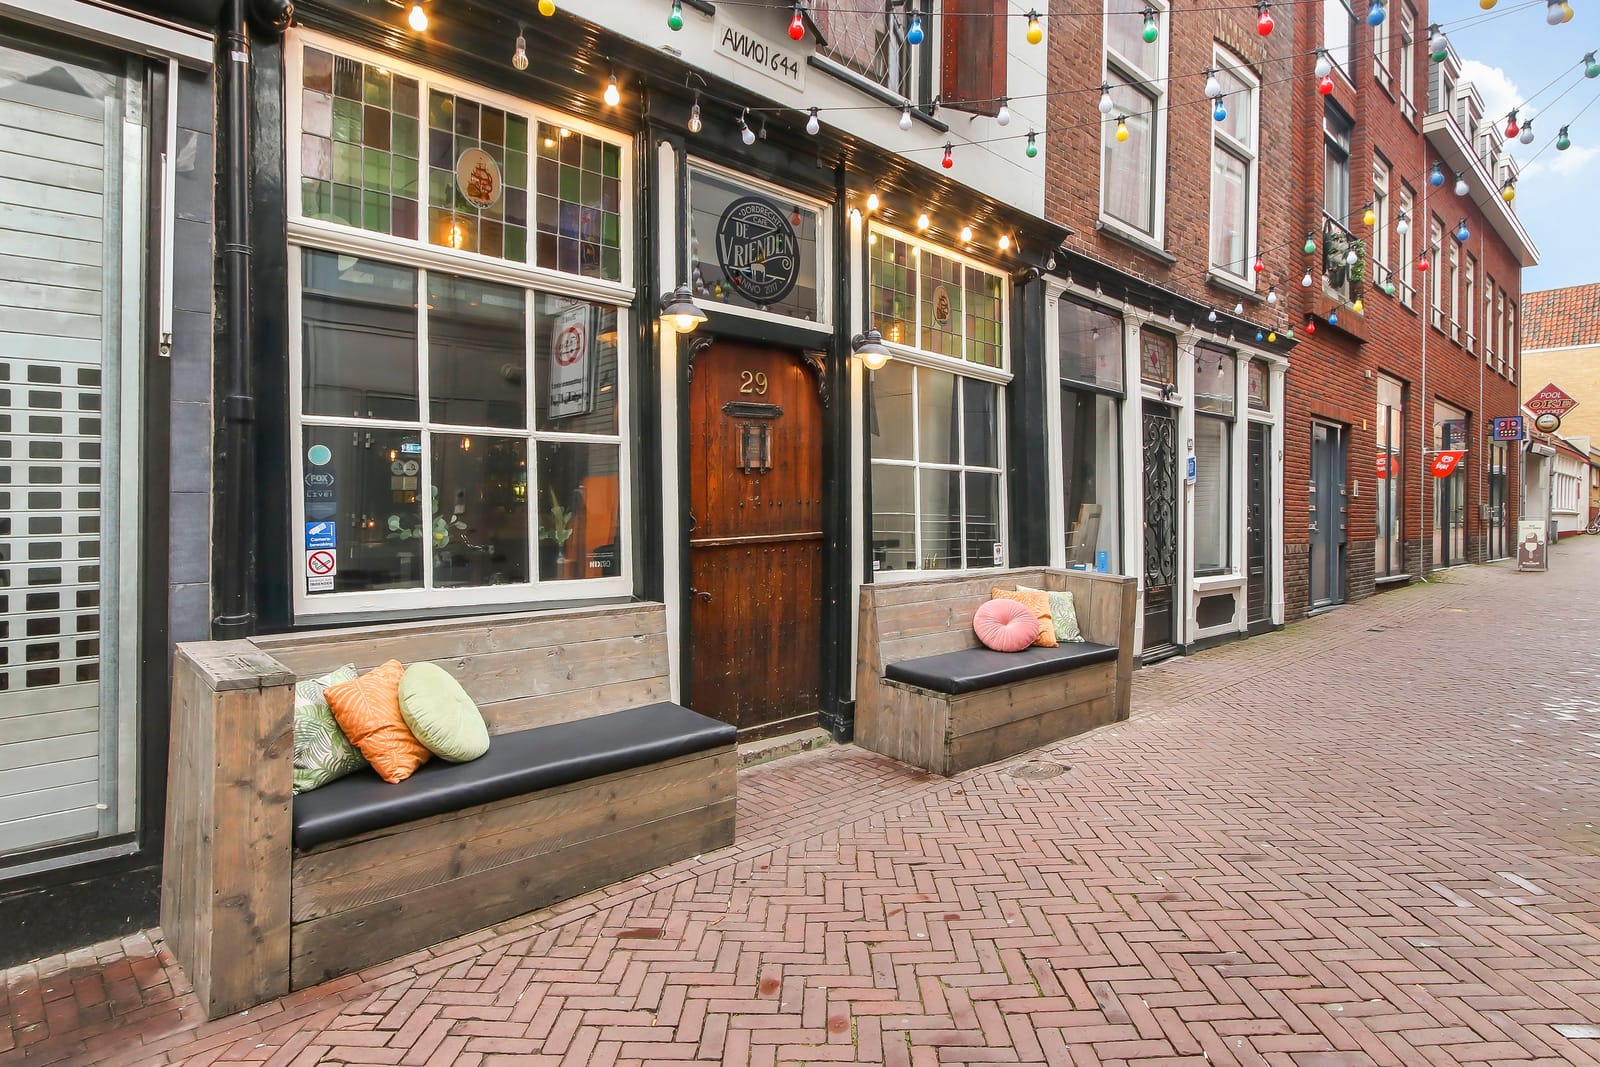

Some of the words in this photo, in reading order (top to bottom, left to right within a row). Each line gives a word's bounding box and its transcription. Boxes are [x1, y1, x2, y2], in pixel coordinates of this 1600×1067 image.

[740, 205, 781, 226] DORDRECHT
[735, 221, 750, 240] DE
[740, 370, 768, 395] 29
[310, 474, 328, 482] FOX
